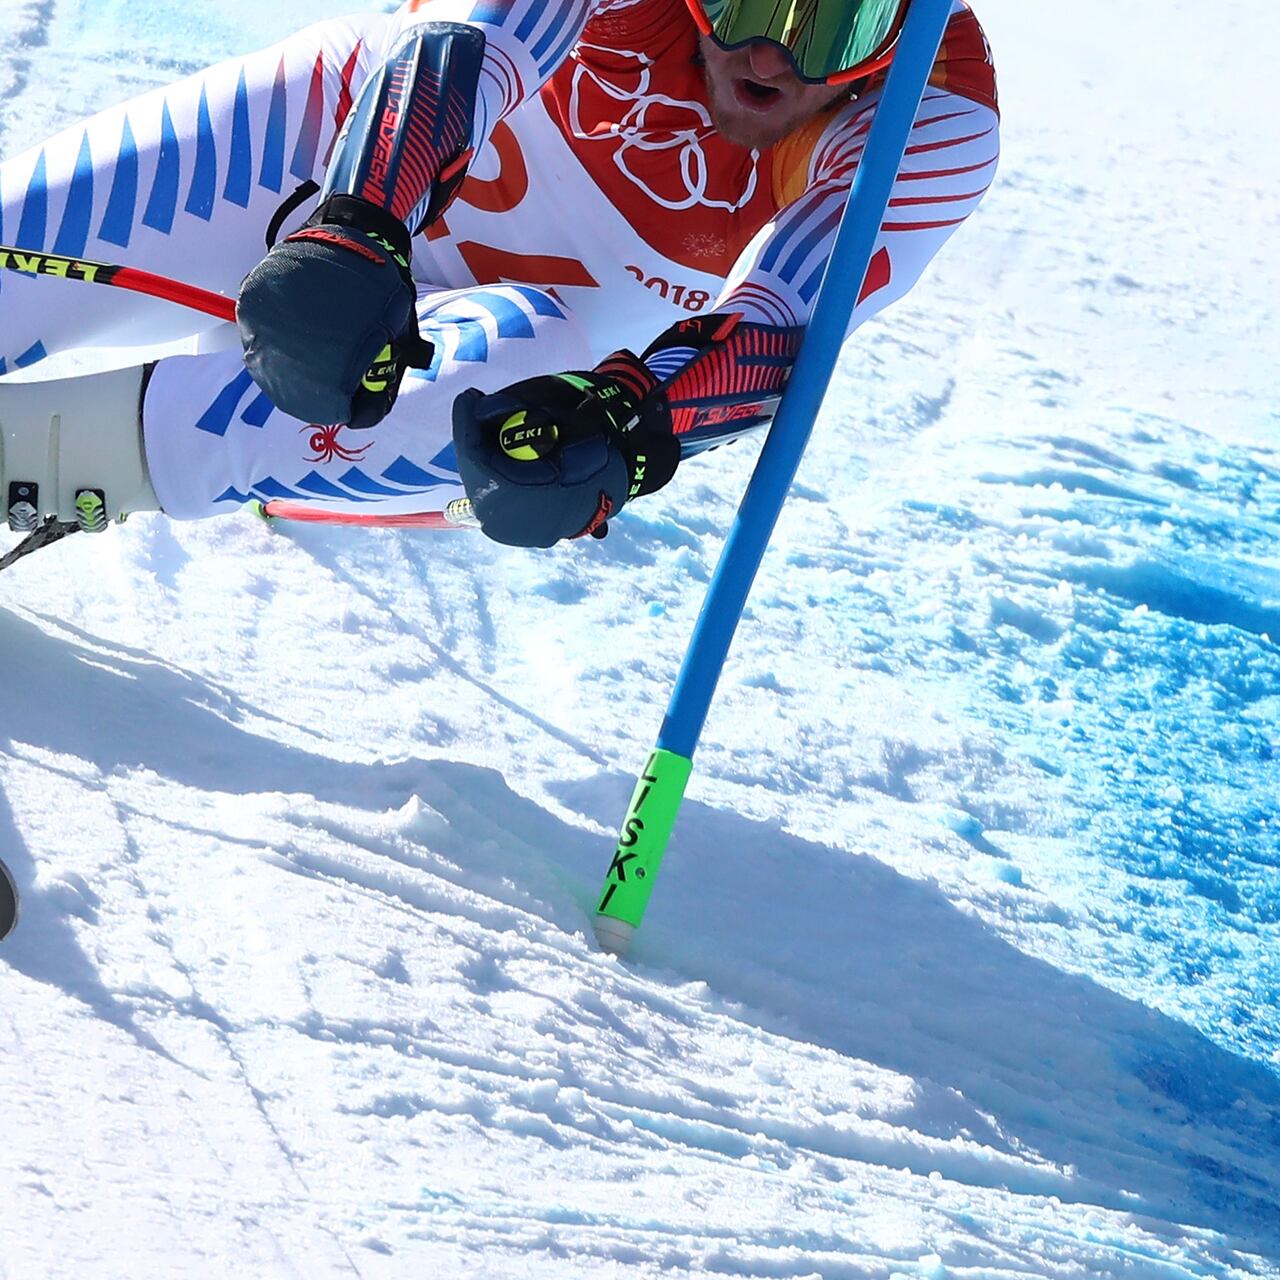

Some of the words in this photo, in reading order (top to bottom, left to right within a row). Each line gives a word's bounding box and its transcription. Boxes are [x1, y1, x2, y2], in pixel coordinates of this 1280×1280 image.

[367, 363, 397, 377] LEKI
[597, 384, 621, 400] LEKI
[503, 427, 543, 446] LEKI
[625, 454, 647, 503] EKI
[598, 752, 658, 912] LISKI
